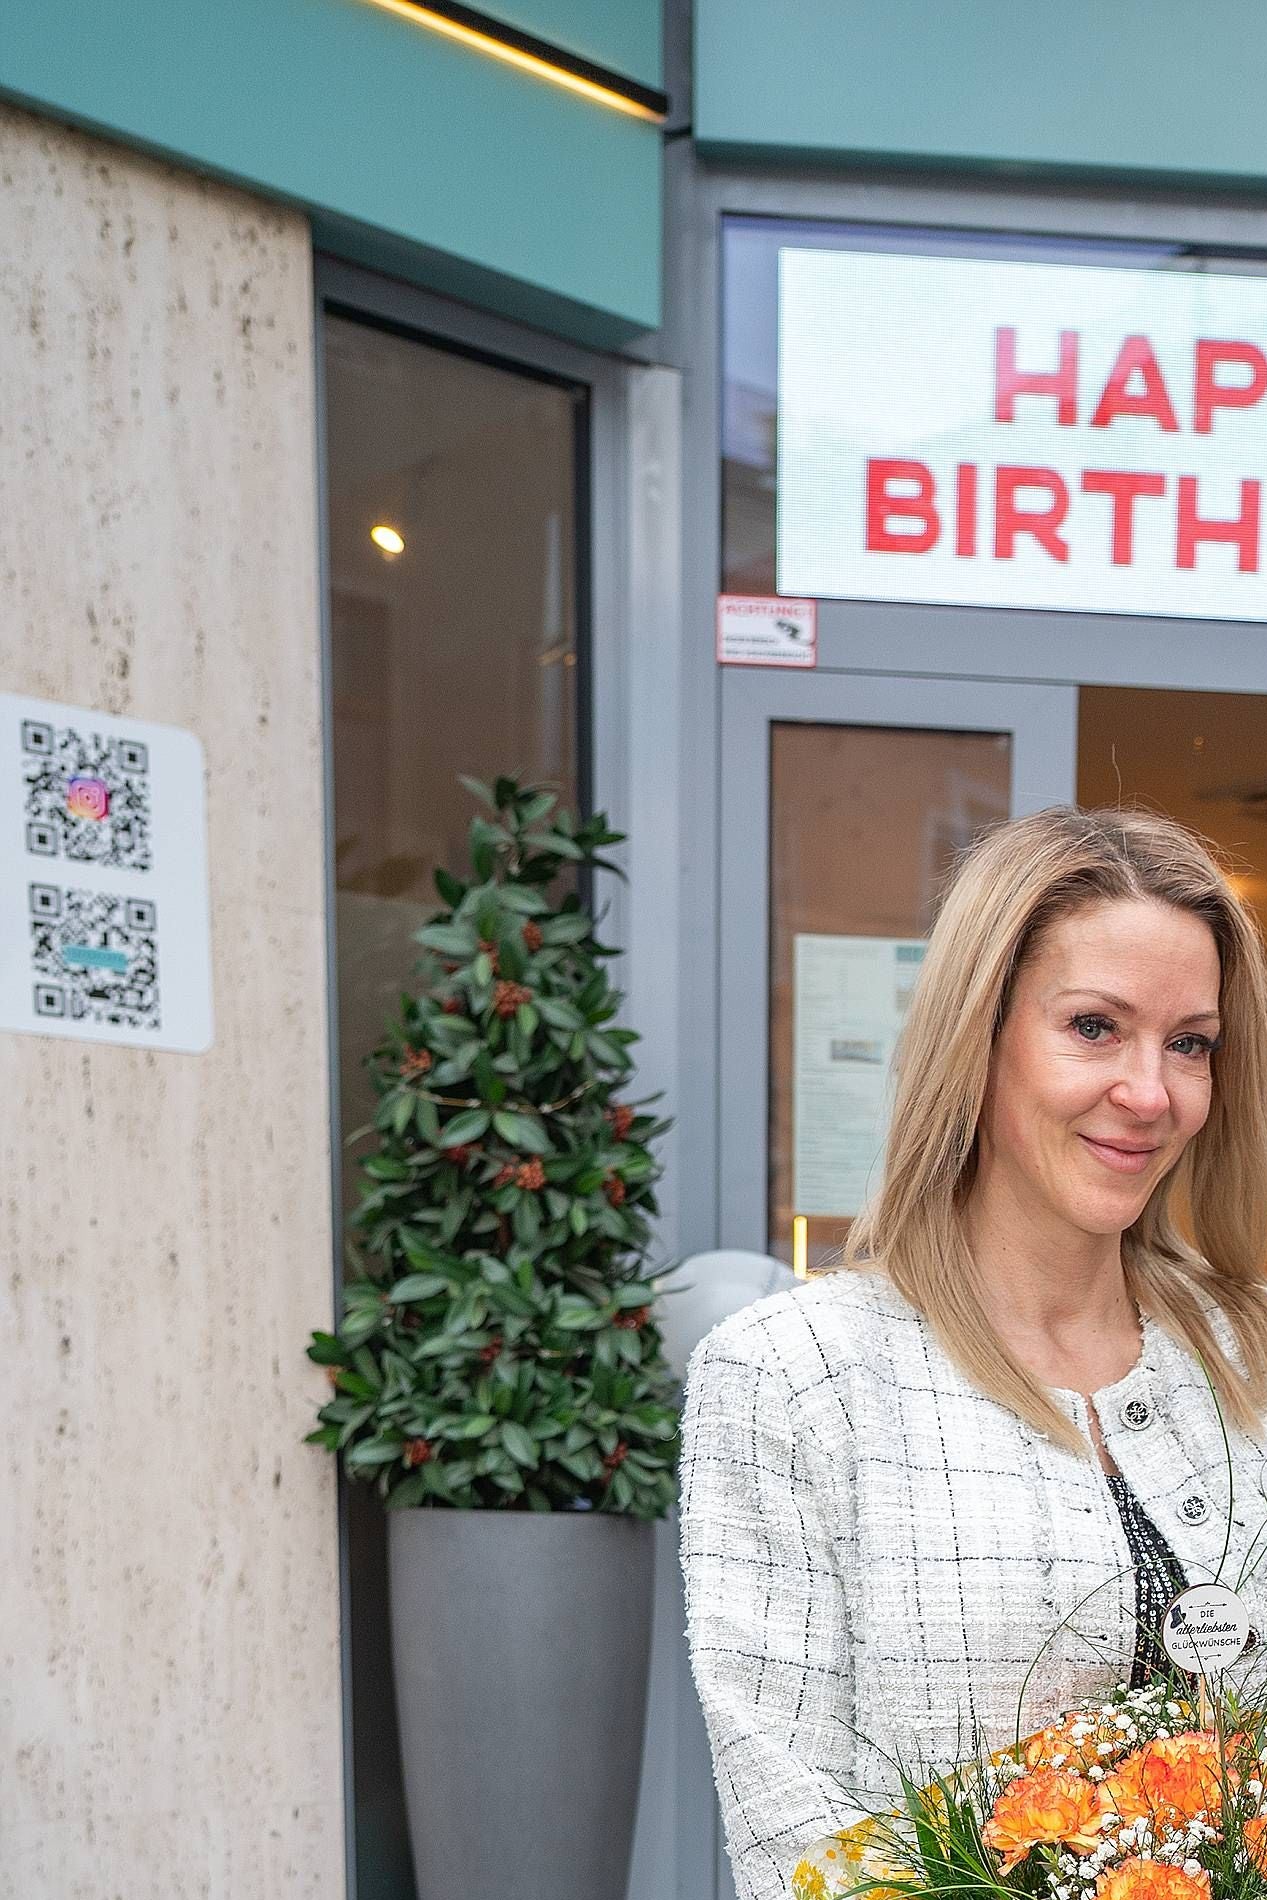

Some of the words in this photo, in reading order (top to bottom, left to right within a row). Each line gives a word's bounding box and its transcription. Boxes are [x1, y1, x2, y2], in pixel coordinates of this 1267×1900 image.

[1200, 1610, 1215, 1618] DIE
[1176, 1621, 1238, 1635] allerliebsten
[1171, 1638, 1241, 1650] GLÜCKWÜNSCHE
